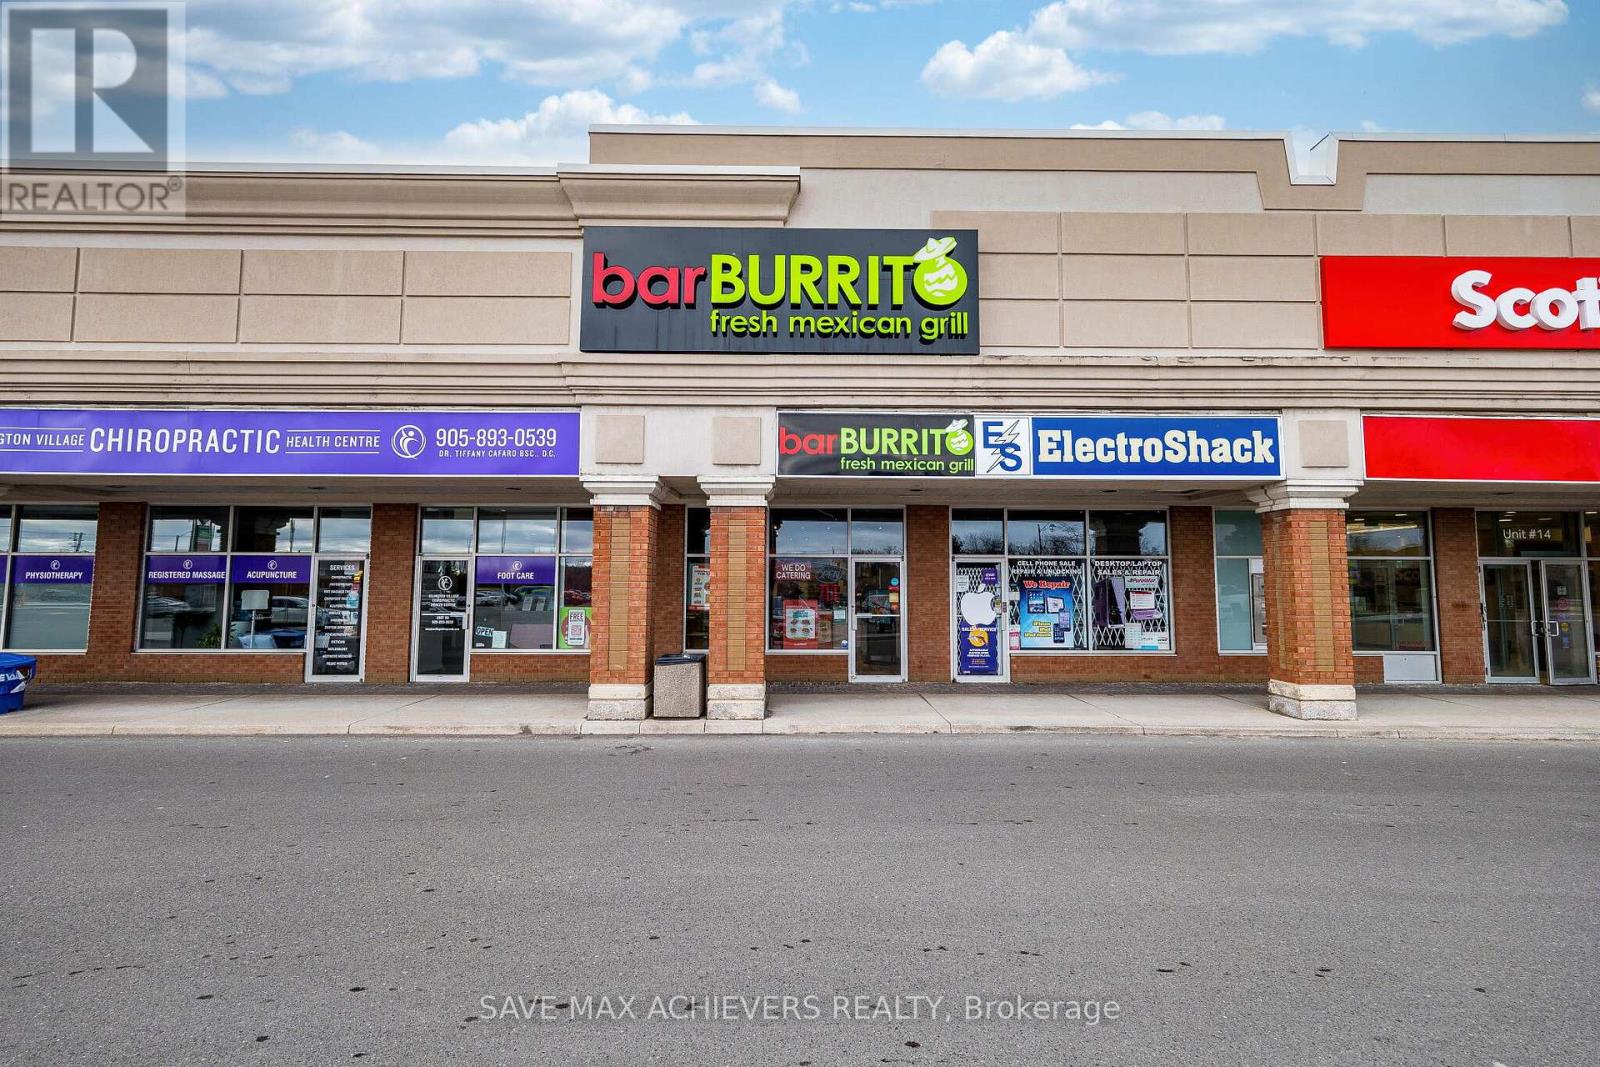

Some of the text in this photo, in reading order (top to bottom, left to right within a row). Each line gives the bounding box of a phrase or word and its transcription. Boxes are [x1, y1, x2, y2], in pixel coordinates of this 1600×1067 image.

[1451, 269, 1600, 331] Scot
[710, 310, 969, 340] fresh mexican grill
[36, 433, 85, 446] VILLAGE
[89, 428, 281, 454] CHIROPRACTIC
[286, 435, 330, 448] HEALTH
[334, 435, 381, 448] CENTRE
[436, 428, 557, 447] 905-893-0539
[1037, 429, 1275, 464] ElectroShack
[438, 449, 452, 457] DR.
[455, 449, 486, 457] TIFFANY
[488, 449, 517, 457] CAFARO
[840, 457, 974, 473] fresh mexican grill
[1502, 528, 1552, 540] Unit #14
[25, 571, 83, 579] PHYSIOTHERAPY
[148, 571, 225, 579] REGISTERED MASSAGE
[247, 571, 297, 579] ACUPUNCTURE
[497, 572, 534, 580] FOOT CARE
[776, 571, 811, 579] CATERING
[1023, 580, 1071, 590] We Repair
[570, 611, 584, 621] FREE
[475, 626, 495, 637] OPEN
